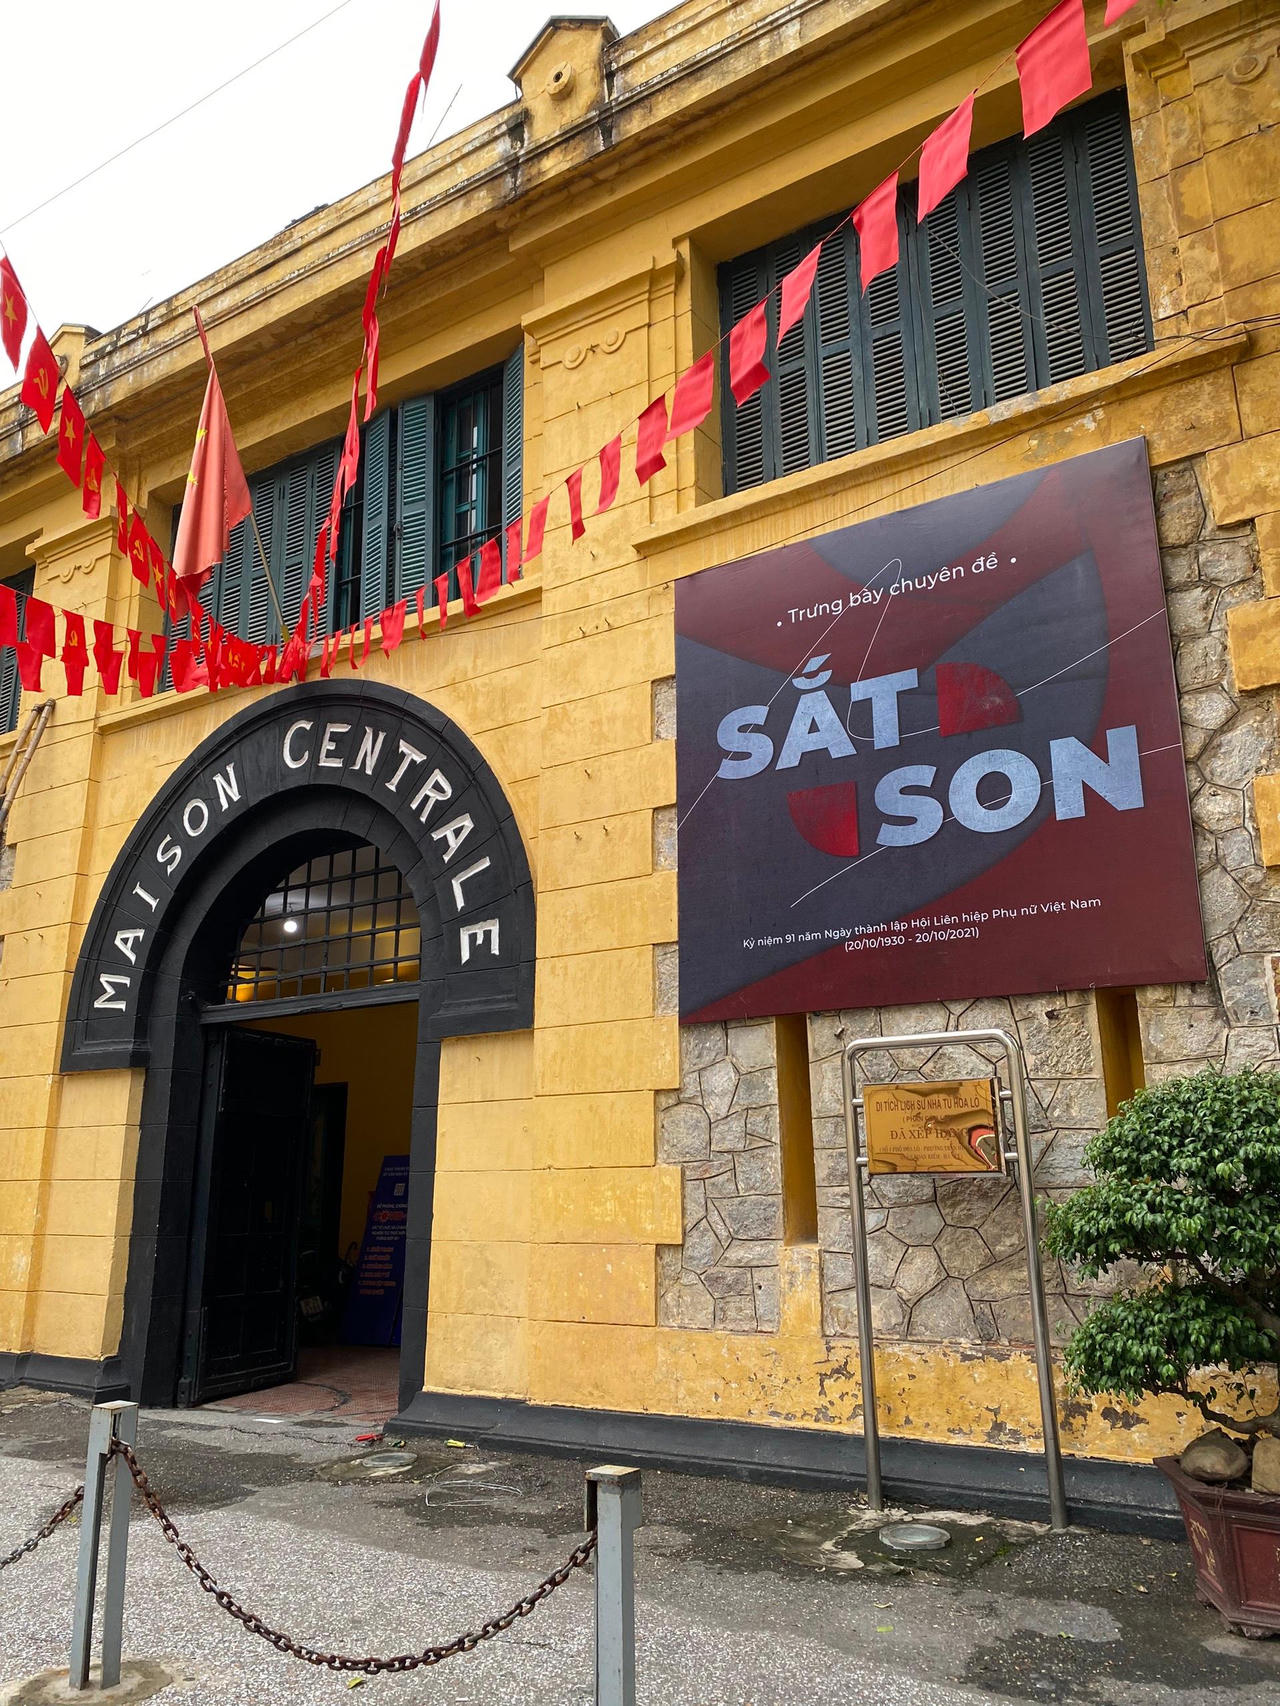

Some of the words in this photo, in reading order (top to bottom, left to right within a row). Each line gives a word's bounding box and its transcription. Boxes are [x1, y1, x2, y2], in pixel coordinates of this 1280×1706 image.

[788, 598, 843, 623] Trưng
[849, 586, 885, 607] bày
[890, 566, 965, 597] chuyên
[971, 551, 999, 574] đề
[715, 652, 919, 781] SẮT
[873, 724, 1145, 847] SON
[93, 762, 242, 1012] MAISON
[282, 719, 501, 966] CENTRALE
[757, 935, 783, 946] niệm
[785, 933, 796, 943] 91
[798, 931, 822, 942] năm
[824, 927, 853, 941] Ngày
[854, 922, 888, 935] thành
[890, 919, 909, 932] lập
[911, 917, 931, 930] Hội
[933, 914, 959, 926] Liên
[962, 911, 989, 924] hiệp
[992, 907, 1017, 920] Phụ
[1021, 904, 1038, 916] nữ
[1040, 902, 1067, 915] Việt
[1070, 897, 1102, 909] Nam
[844, 935, 905, 953] (20/10/1930
[915, 926, 980, 943] 20/10/2021)
